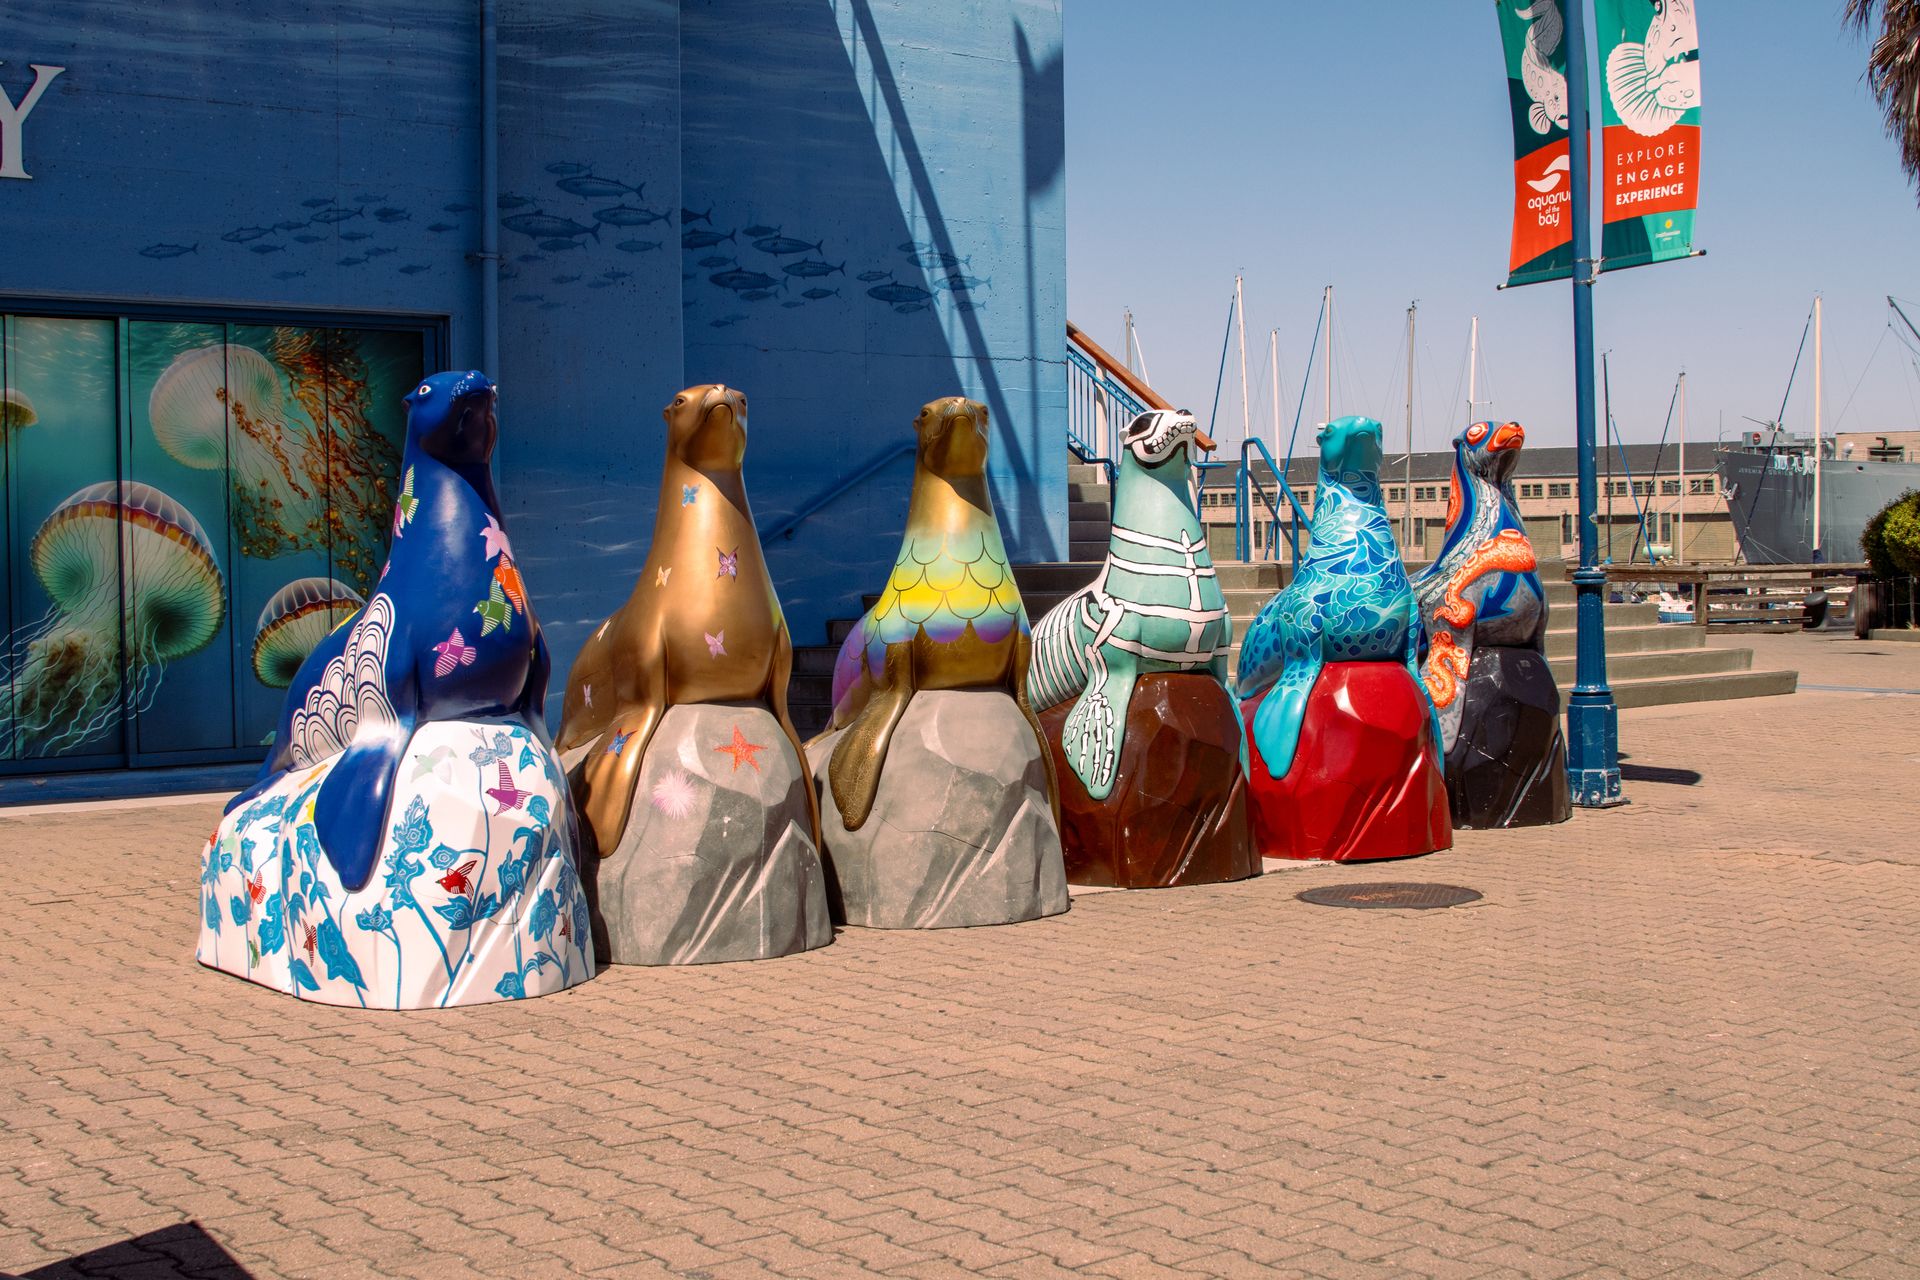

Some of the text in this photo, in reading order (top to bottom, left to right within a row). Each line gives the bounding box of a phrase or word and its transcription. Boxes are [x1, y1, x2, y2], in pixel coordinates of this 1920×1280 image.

[0, 62, 66, 180] Y
[1617, 142, 1684, 166] EXPLORE
[1616, 162, 1684, 186] ENGAGE
[1528, 191, 1571, 211] aquariu
[1616, 183, 1684, 206] EXPERIENCE
[1538, 212, 1560, 227] bay
[1545, 204, 1560, 215] of the
